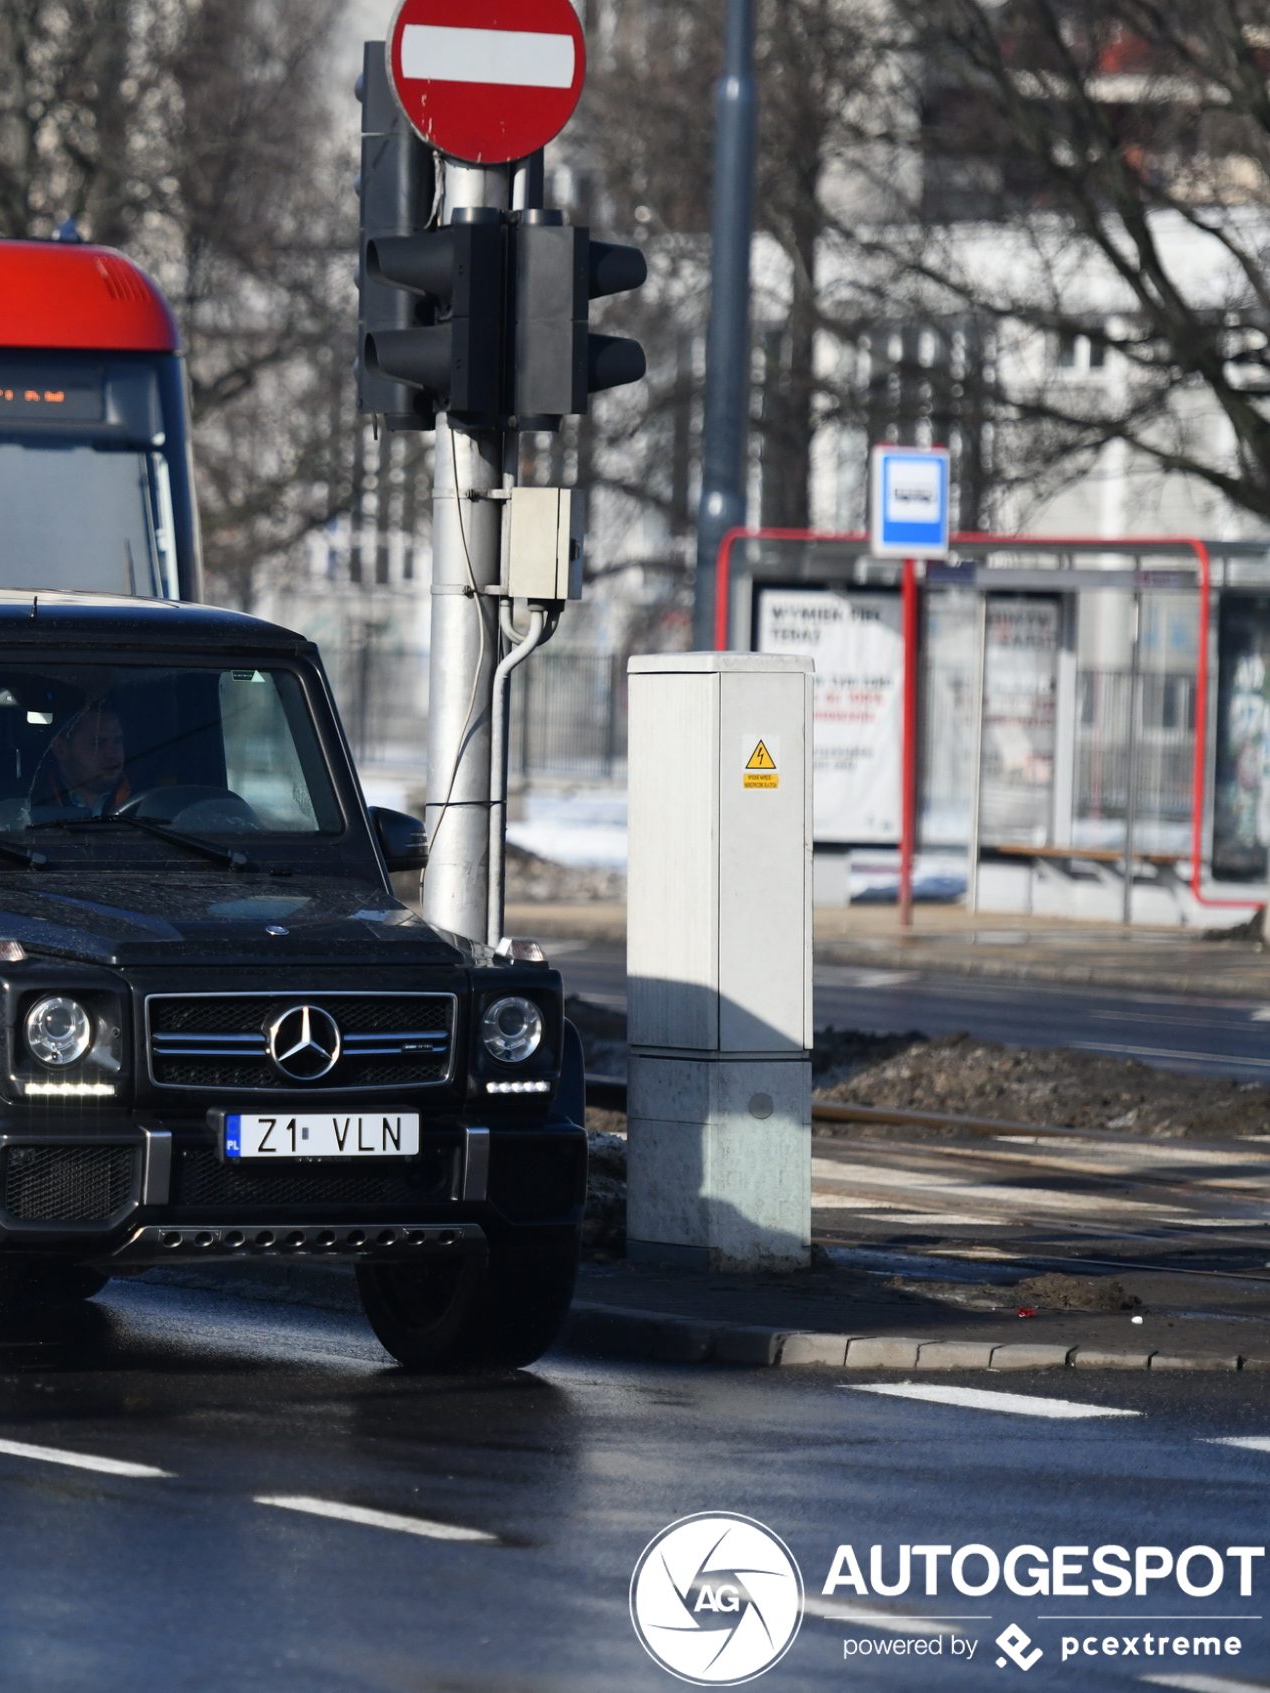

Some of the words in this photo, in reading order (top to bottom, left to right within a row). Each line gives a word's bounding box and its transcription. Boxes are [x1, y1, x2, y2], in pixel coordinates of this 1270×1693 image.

[227, 1140, 239, 1150] PL
[257, 1118, 297, 1152] Z1
[332, 1117, 401, 1152] VLN
